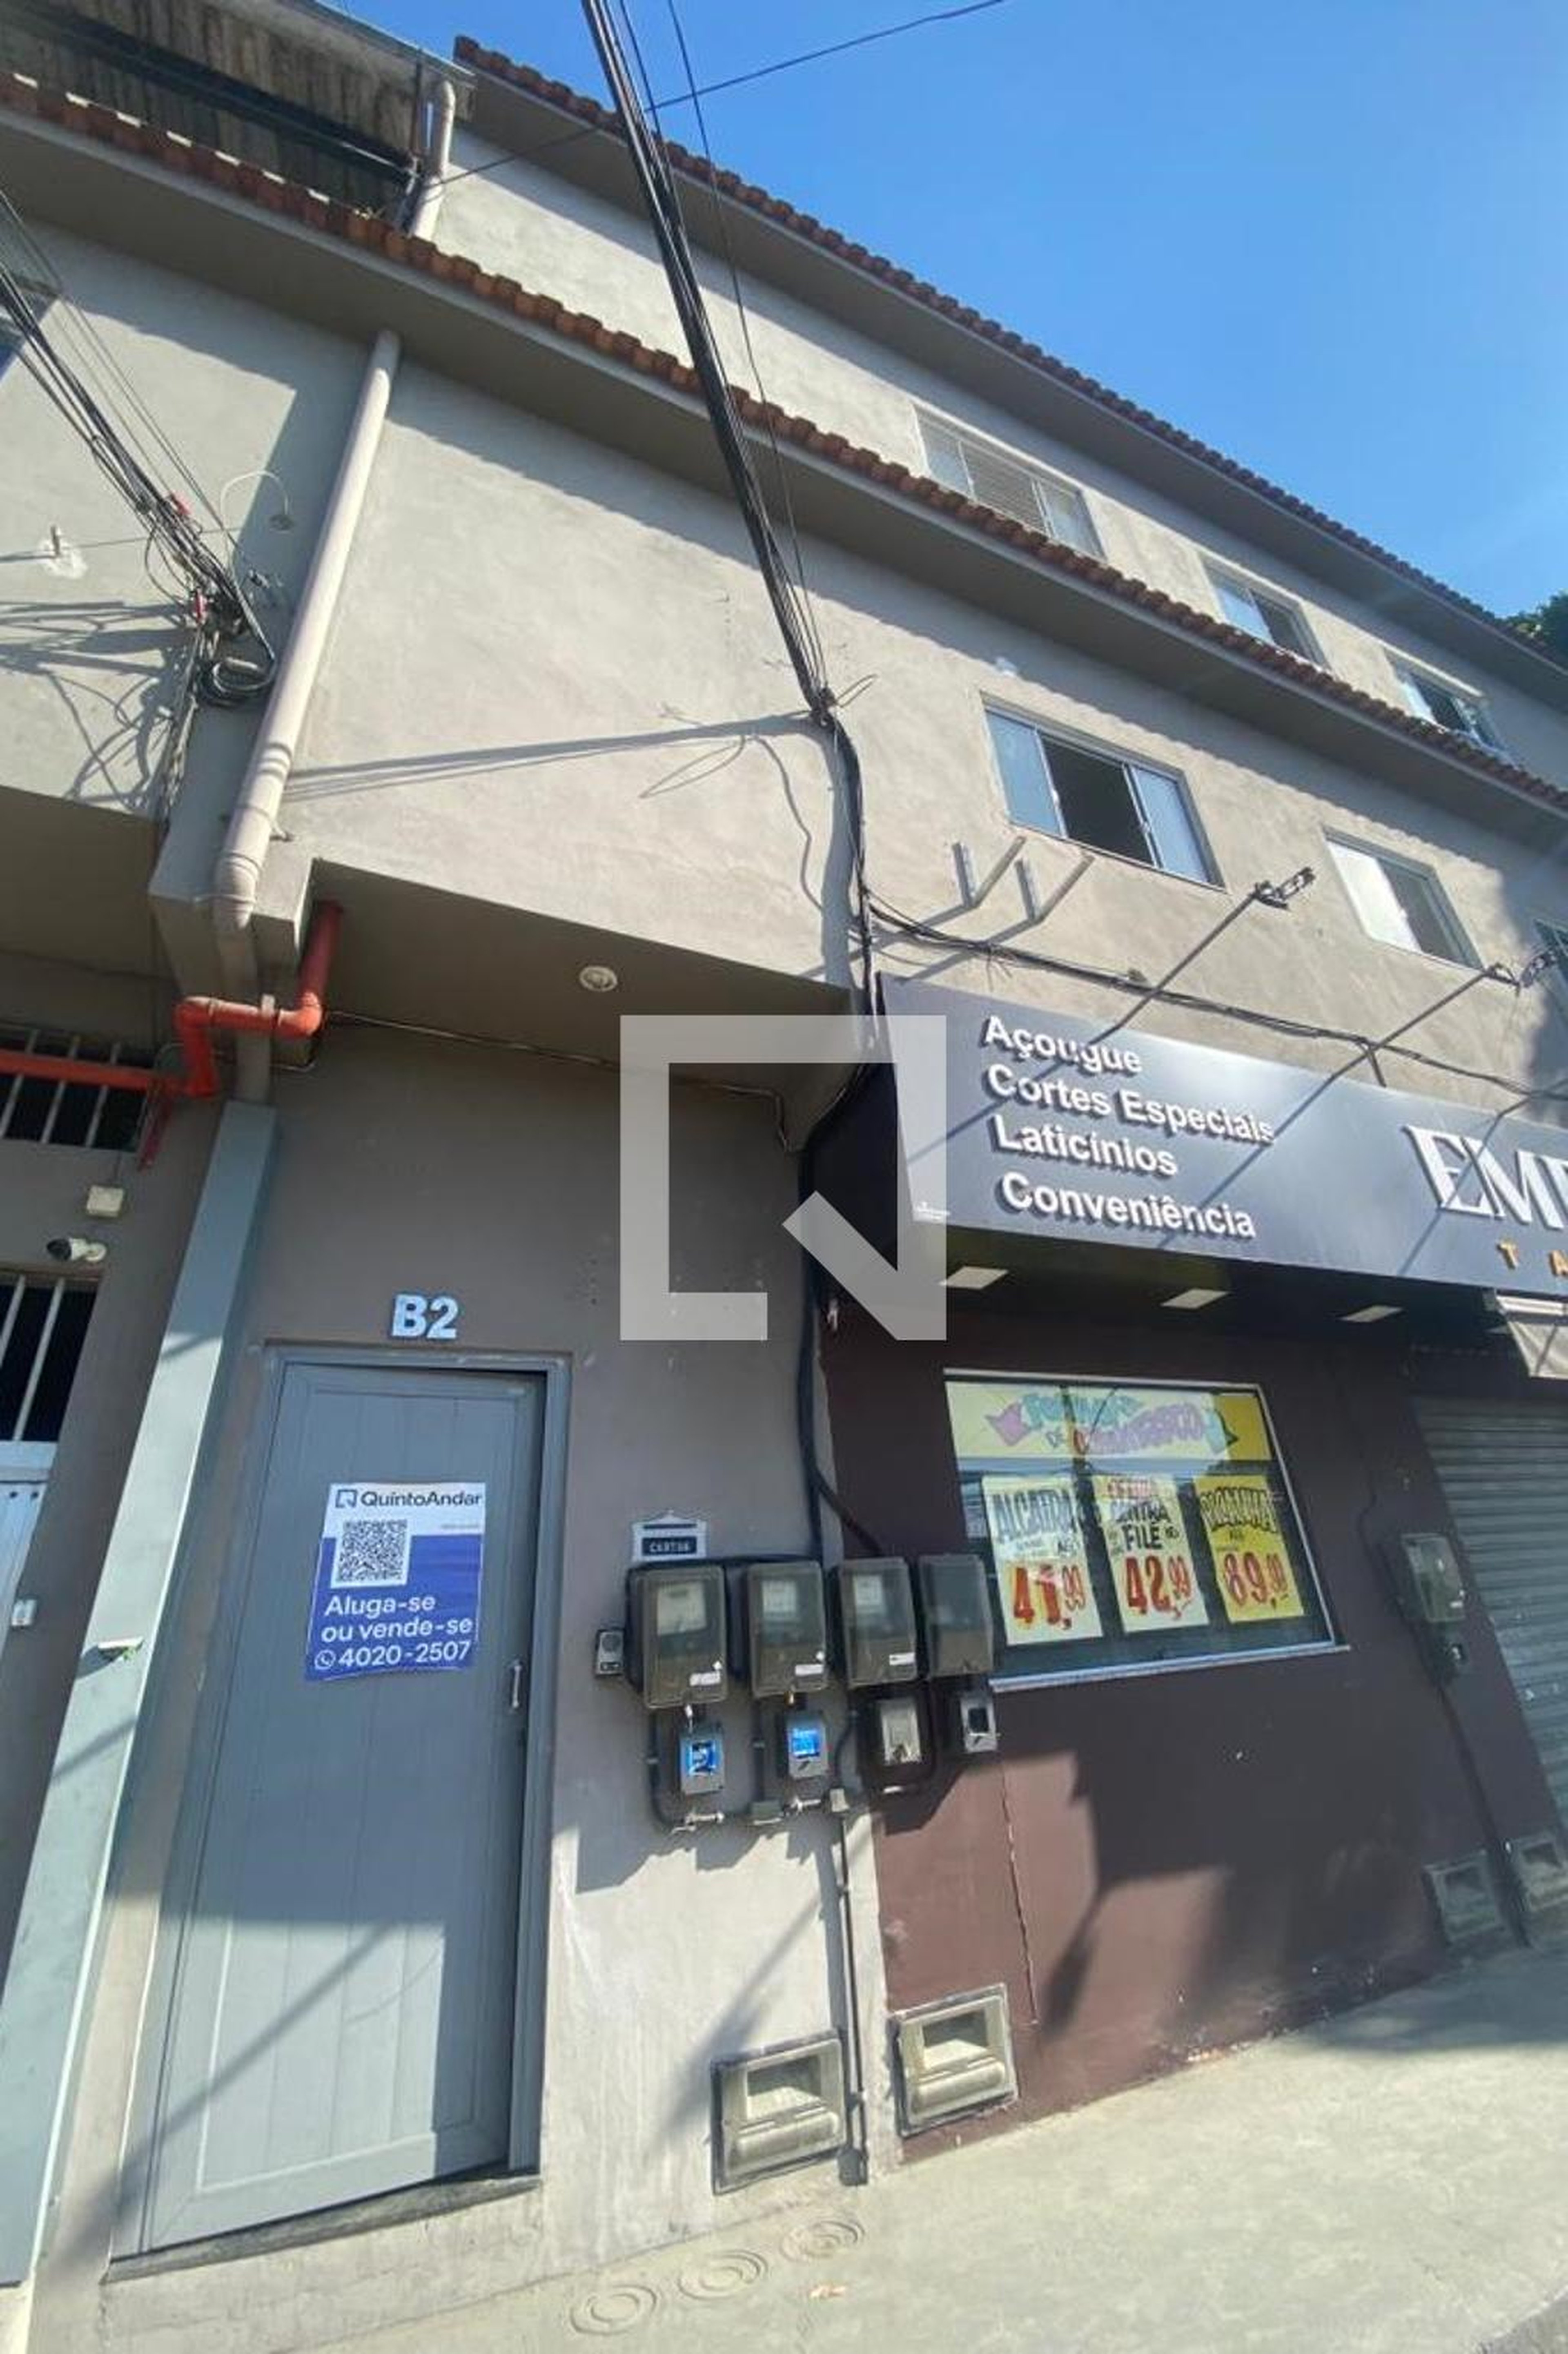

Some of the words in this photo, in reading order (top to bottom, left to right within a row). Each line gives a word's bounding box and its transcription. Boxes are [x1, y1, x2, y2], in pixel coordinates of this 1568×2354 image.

[982, 1015, 1143, 1074] Açougue
[987, 1063, 1111, 1116] Cortes
[1118, 1090, 1274, 1144] Especiais
[1001, 1172, 1256, 1238] Conveniência
[391, 1294, 459, 1339] B2
[361, 1491, 482, 1506] QuintoAndar
[325, 1595, 436, 1619] Aluga-se
[321, 1625, 353, 1642] ou
[359, 1616, 473, 1639] vende-se
[338, 1640, 471, 1667] 4020-2507
